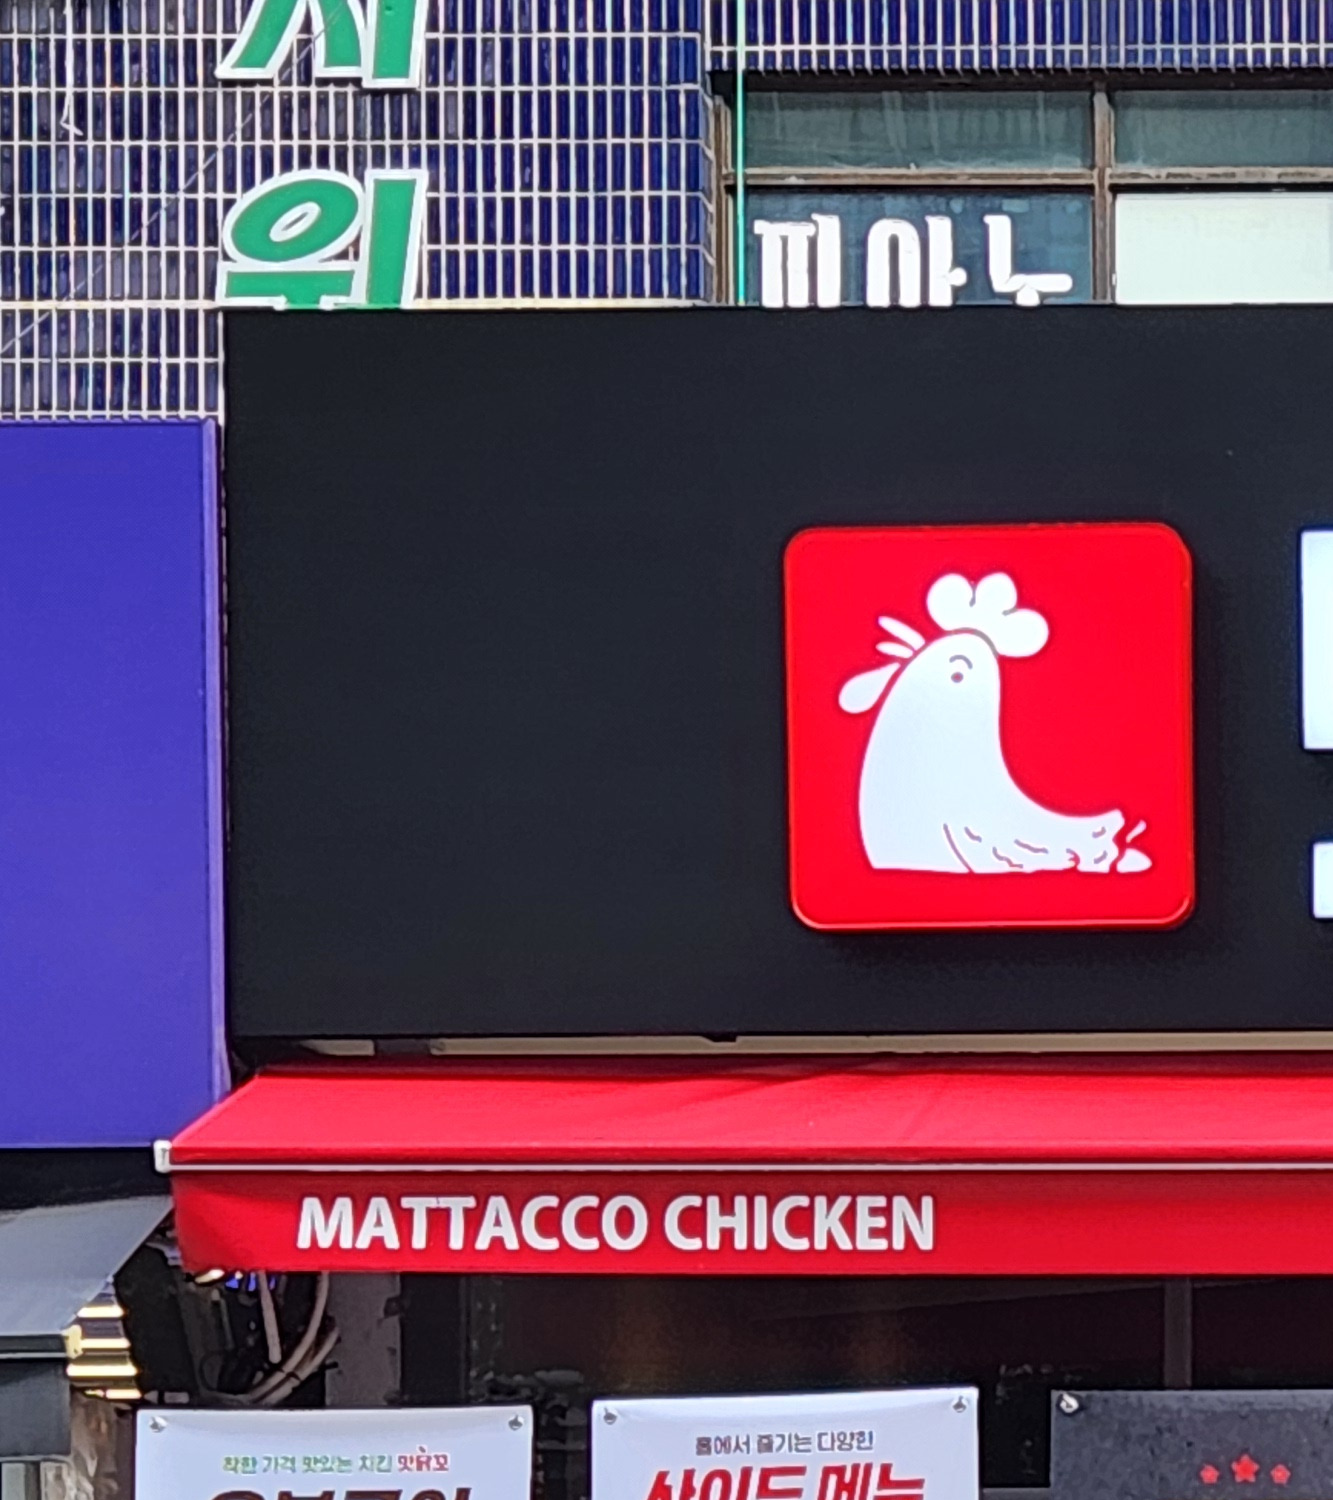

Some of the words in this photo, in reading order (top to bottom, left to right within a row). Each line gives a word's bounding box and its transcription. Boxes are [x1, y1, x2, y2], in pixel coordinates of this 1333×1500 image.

[295, 1195, 648, 1253] MATTACCO
[665, 1195, 935, 1252] CHICKEN
[756, 1432, 813, 1454] 즐기는
[816, 1430, 874, 1452] 다양한
[222, 1454, 258, 1475] 착한
[262, 1454, 297, 1475] 가격
[302, 1453, 354, 1475] 맛있는
[358, 1453, 393, 1474] 치킨
[397, 1450, 450, 1473] 맛닭꼬
